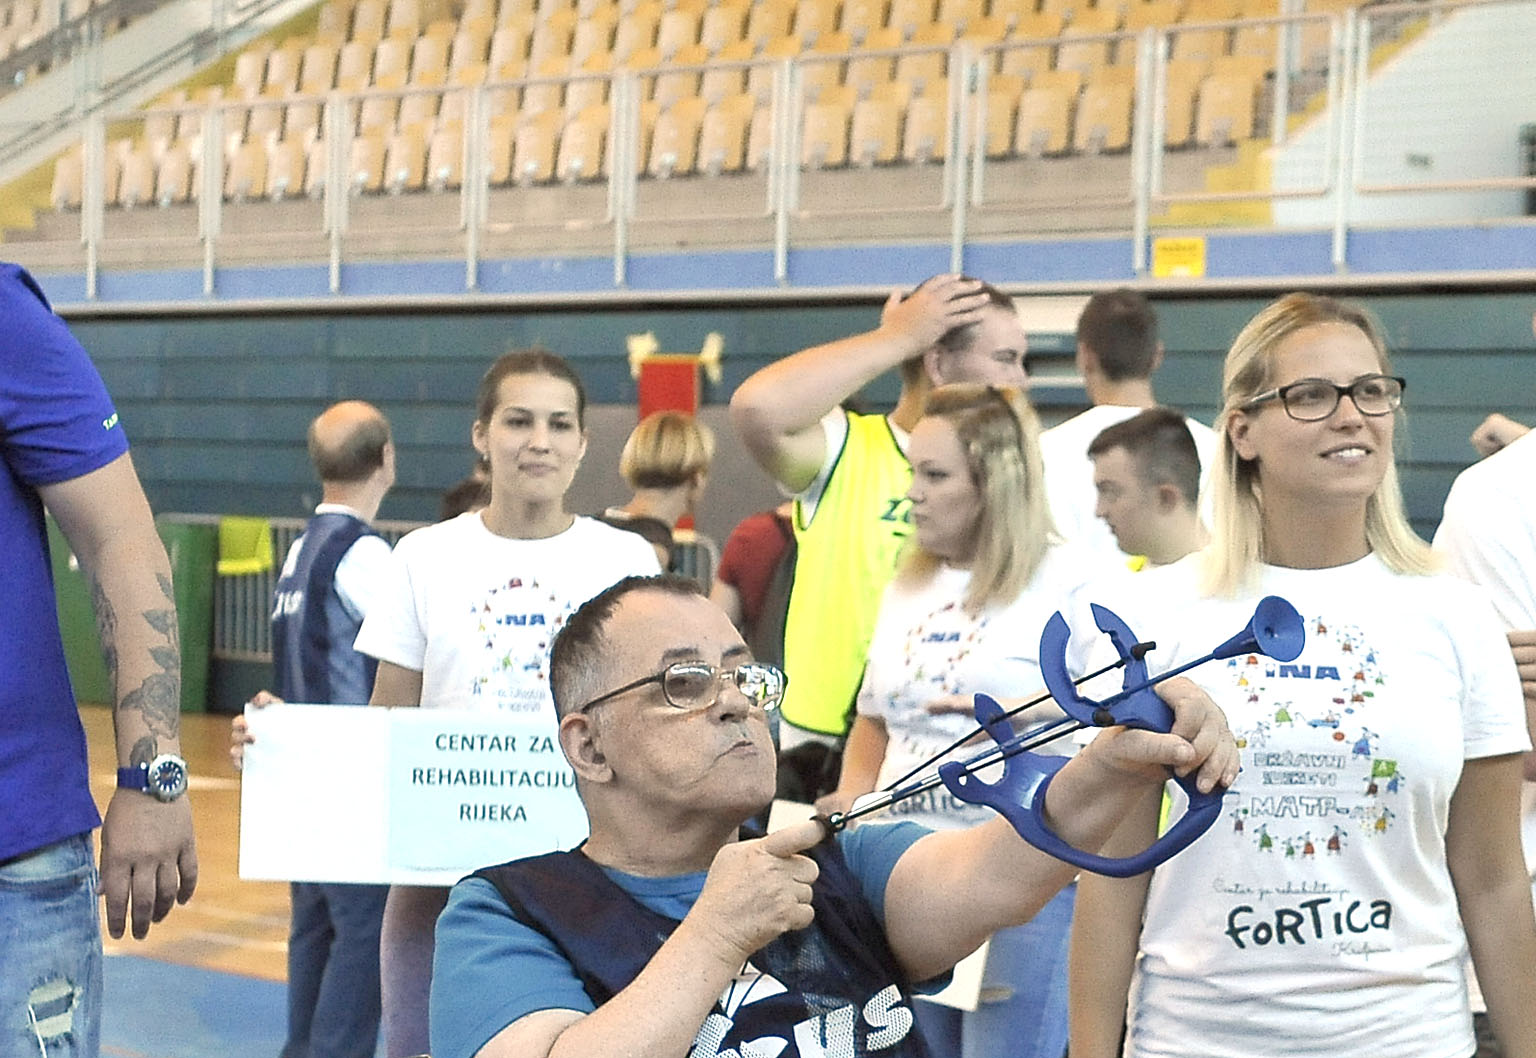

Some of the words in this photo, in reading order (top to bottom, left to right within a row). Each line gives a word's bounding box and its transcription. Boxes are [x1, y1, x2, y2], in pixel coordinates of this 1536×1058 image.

[1266, 664, 1341, 680] INA
[435, 734, 516, 752] CENTAR
[529, 735, 555, 753] ZA
[412, 767, 575, 788] REHABILITACIJU
[459, 803, 527, 822] RIJEKA
